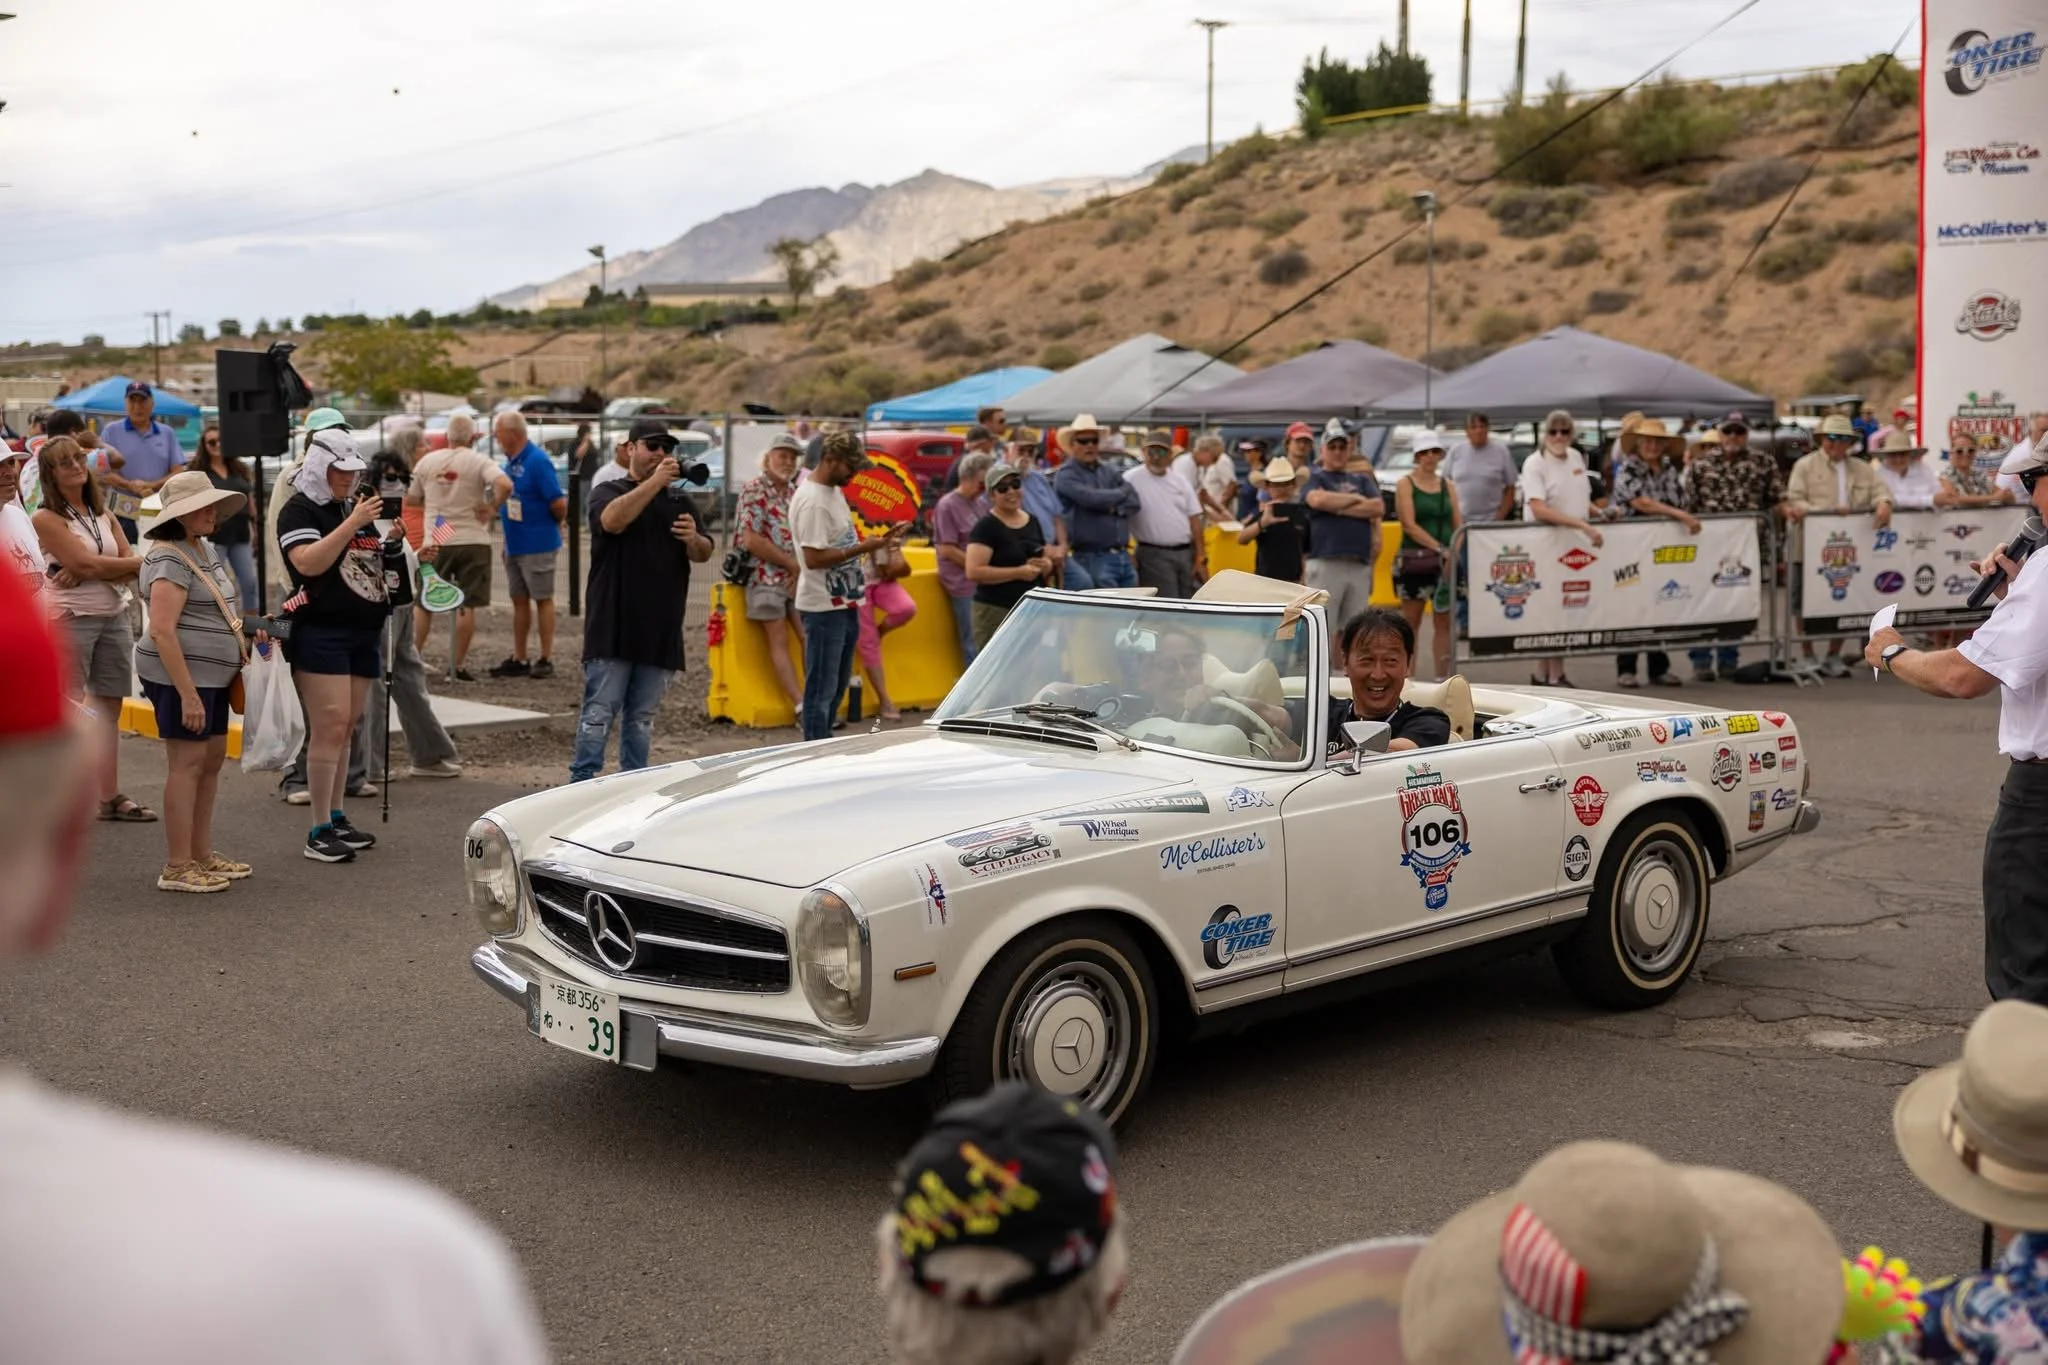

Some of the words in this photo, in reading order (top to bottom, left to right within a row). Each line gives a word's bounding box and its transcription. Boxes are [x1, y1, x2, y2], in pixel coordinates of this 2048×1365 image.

[1974, 48, 2042, 78] TIRE
[1937, 220, 2047, 238] McCollister's
[1613, 562, 1640, 582] WIX
[1697, 715, 1721, 730] WIX
[1725, 714, 1760, 735] JEGS
[1589, 728, 1620, 744] SAMUEL
[1620, 726, 1642, 740] SMITH
[1407, 775, 1441, 787] HEMMINGS
[1225, 791, 1274, 811] PEAK
[1399, 786, 1431, 821] GREAT
[1430, 782, 1461, 813] RACE
[1101, 820, 1128, 828] Wheel
[1101, 827, 1139, 838] Vintiques
[1410, 819, 1460, 849] 106
[1160, 831, 1266, 871] McCollister's
[1566, 850, 1588, 864] SIGN
[969, 861, 1006, 876] X-CUP
[1006, 848, 1052, 866] LEGACY
[1200, 913, 1273, 943] COKER
[1224, 928, 1276, 955] TIRE
[556, 984, 600, 1012] 京都356
[543, 1010, 554, 1029] ね
